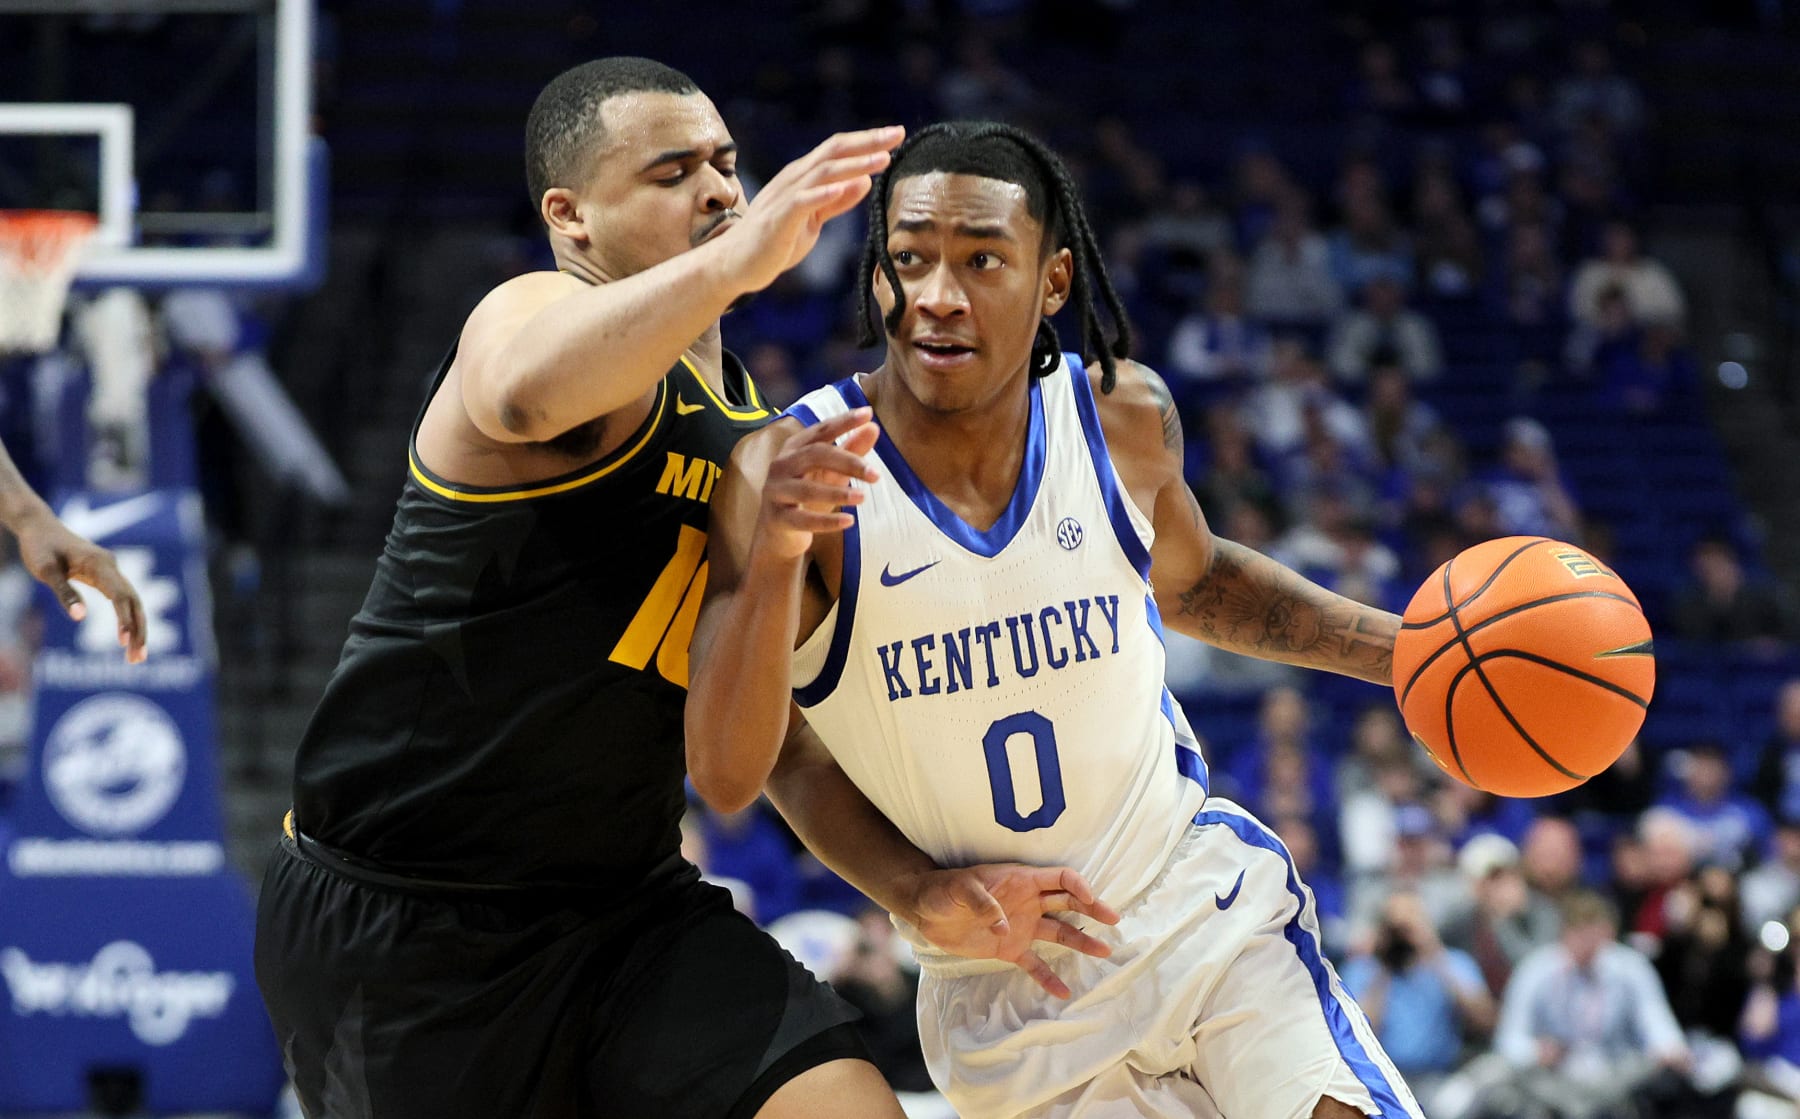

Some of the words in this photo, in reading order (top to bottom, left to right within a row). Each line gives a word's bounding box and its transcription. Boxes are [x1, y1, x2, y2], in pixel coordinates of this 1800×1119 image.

[655, 451, 722, 503] MI
[1058, 518, 1082, 550] SEC
[877, 595, 1119, 702] KENTUCKY
[982, 710, 1066, 833] 0
